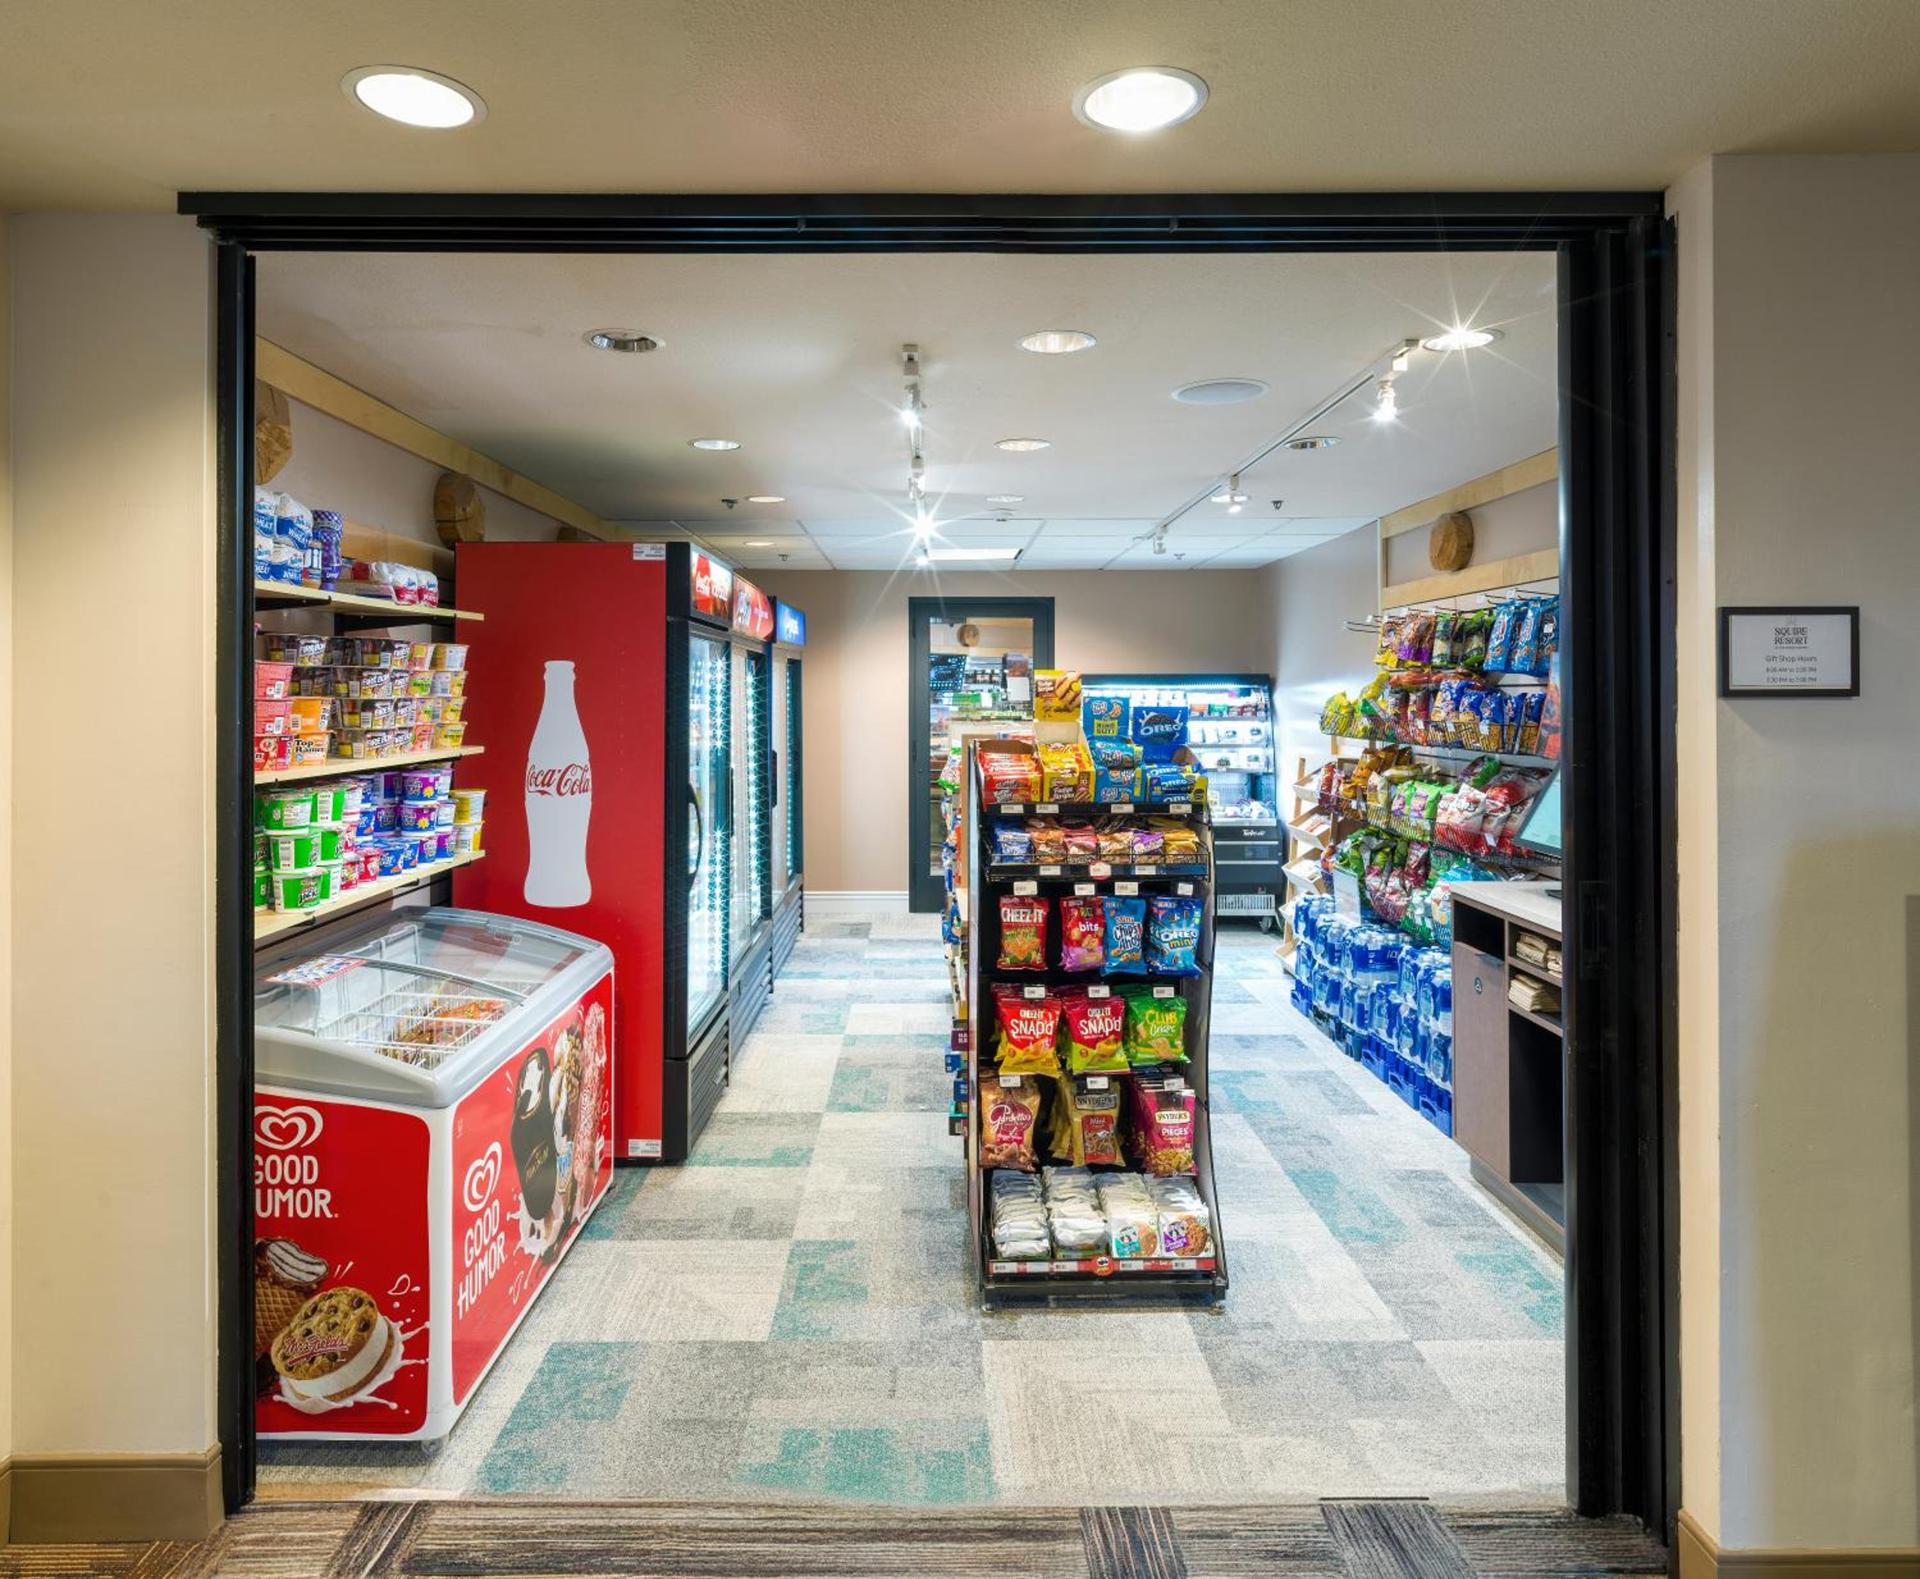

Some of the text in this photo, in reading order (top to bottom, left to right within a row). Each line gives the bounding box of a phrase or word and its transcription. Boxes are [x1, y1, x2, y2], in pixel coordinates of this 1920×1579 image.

[1774, 626, 1808, 636] SQUIRE
[1774, 636, 1808, 645] RESORT
[1779, 655, 1796, 663] Shop
[1140, 723, 1182, 736] OREO
[295, 739, 314, 748] Top
[1001, 907, 1044, 923] CHEEZ-IT
[1079, 921, 1100, 932] bits
[464, 1199, 500, 1268] GOOD
[458, 1232, 506, 1319] HUMOR
